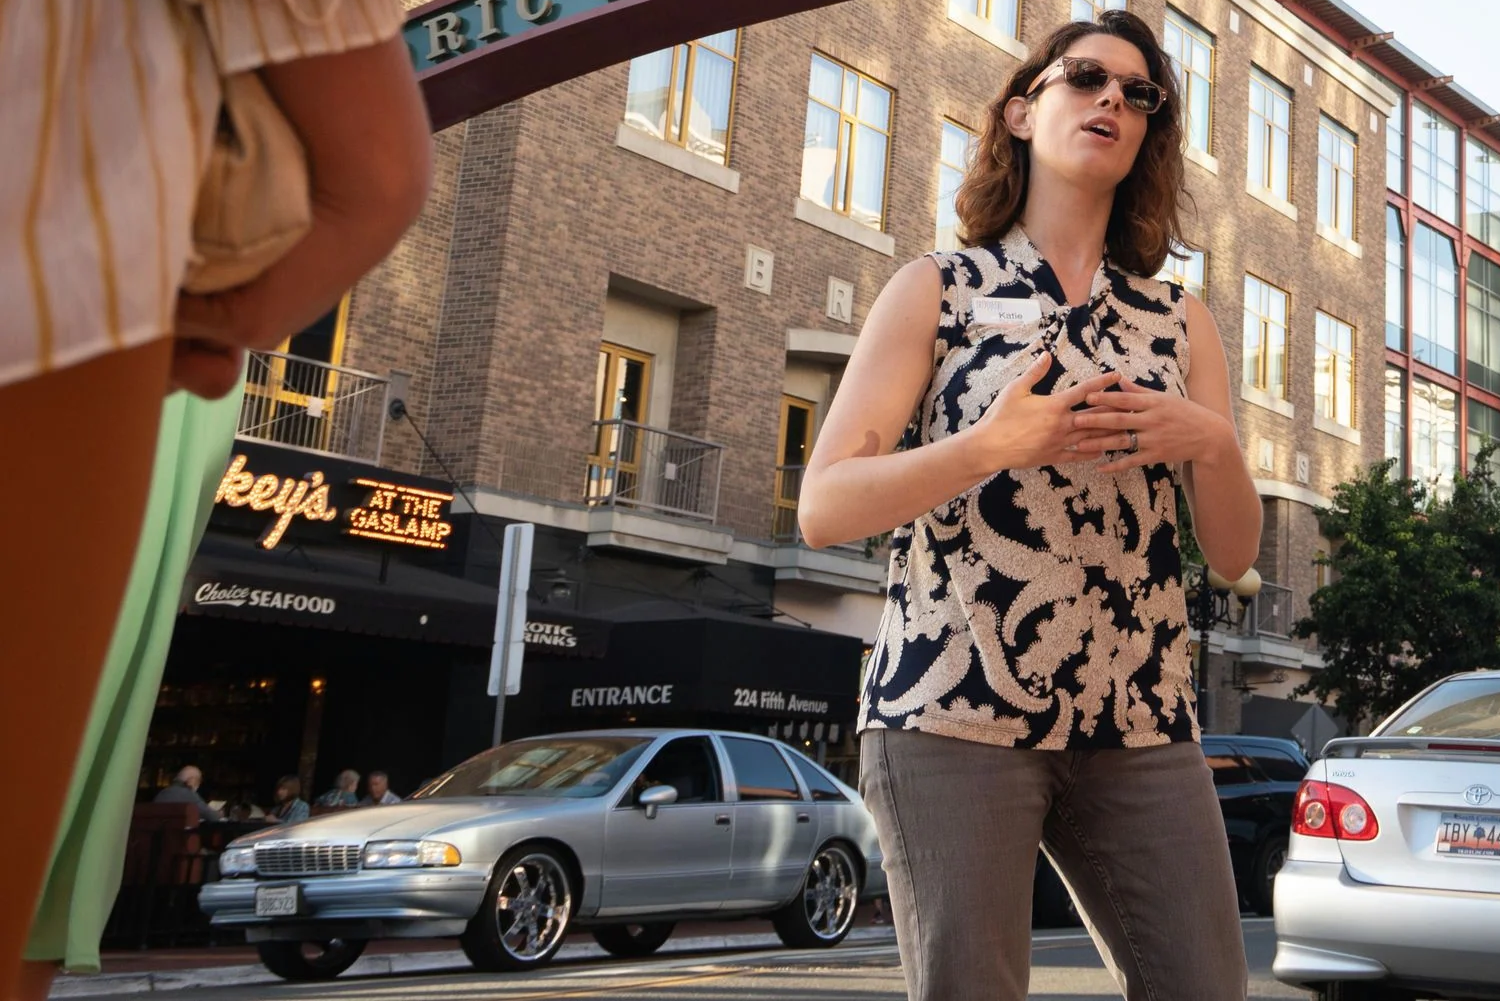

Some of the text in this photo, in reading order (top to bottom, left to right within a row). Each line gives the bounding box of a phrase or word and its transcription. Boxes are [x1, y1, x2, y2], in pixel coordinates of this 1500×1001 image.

[999, 312, 1023, 320] Katie
[369, 490, 441, 519] AT THE
[350, 508, 451, 541] GASLAMP
[195, 582, 335, 614] Choice SEAFOOD
[571, 684, 673, 707] ENTRANCE
[734, 688, 828, 713] 224 Fifth Avenue
[1441, 823, 1470, 843] IBY
